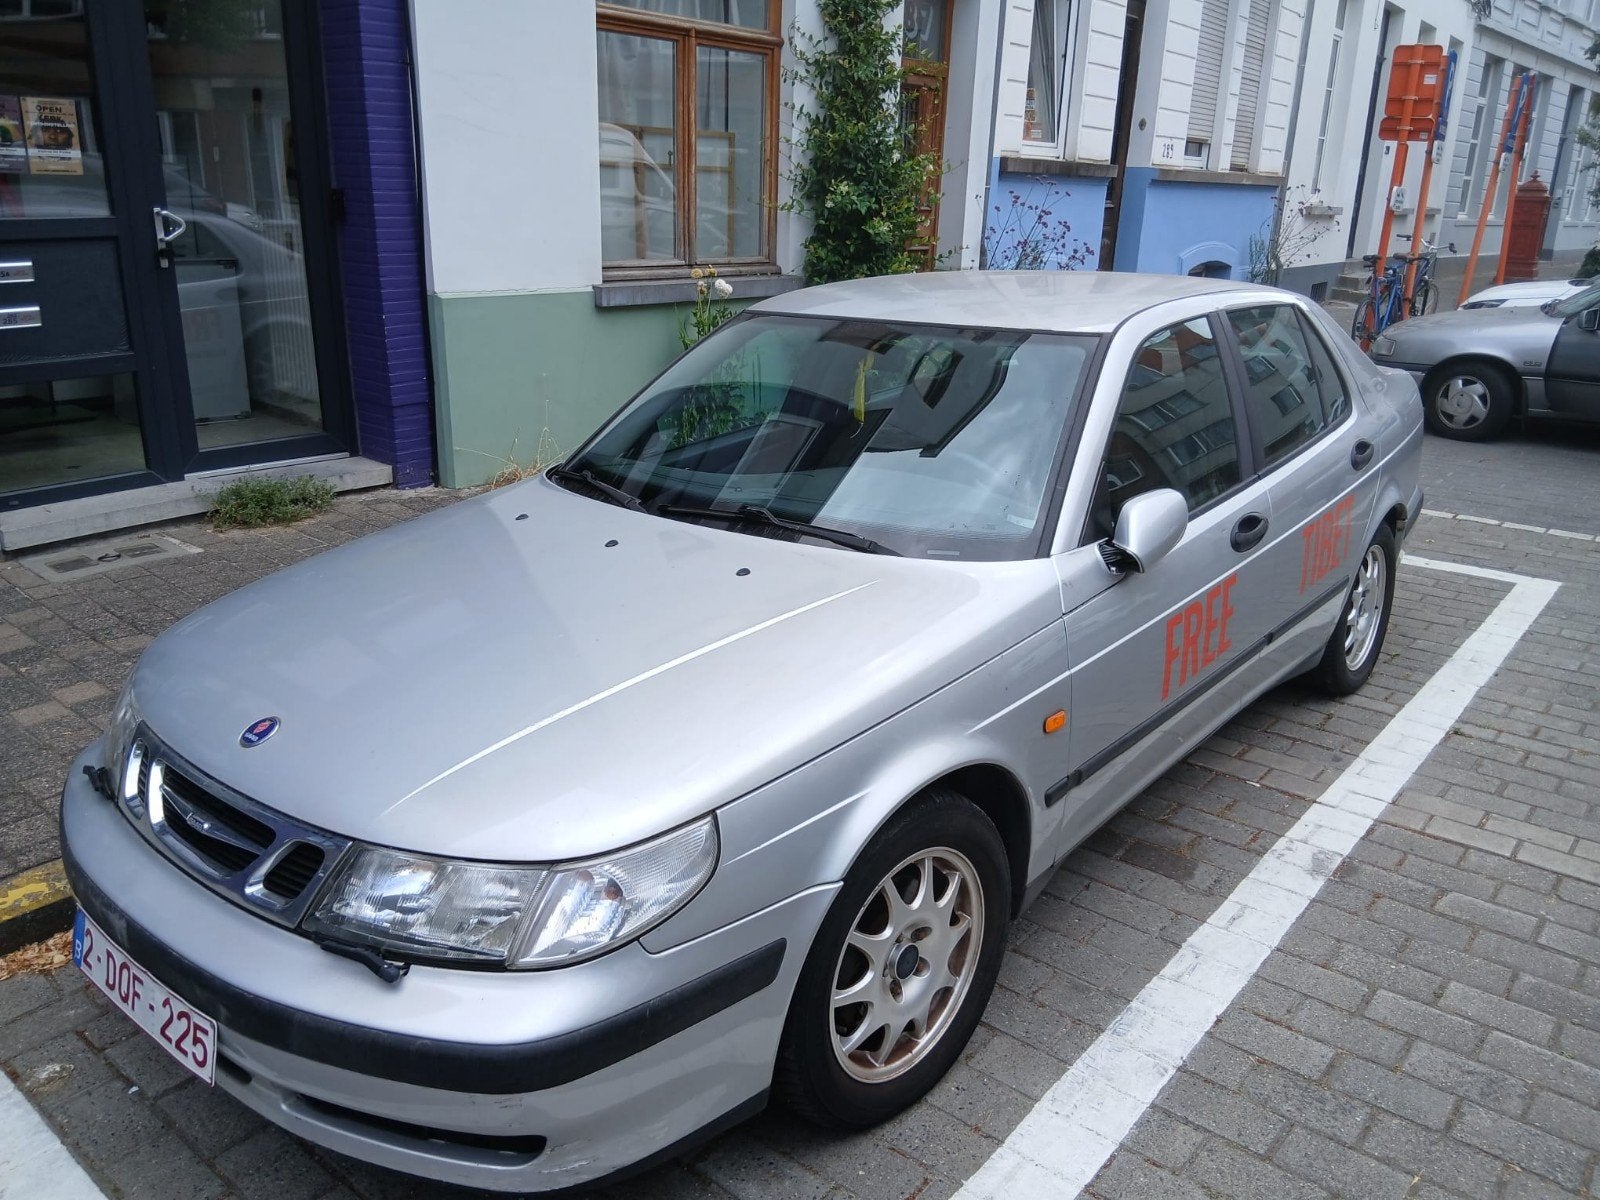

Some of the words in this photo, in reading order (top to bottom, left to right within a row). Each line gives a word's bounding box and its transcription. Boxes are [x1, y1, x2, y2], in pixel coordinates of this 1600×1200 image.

[35, 104, 62, 113] OPEN
[1161, 572, 1238, 701] FREE
[1299, 494, 1355, 596] TIBET
[75, 939, 83, 960] B
[82, 927, 209, 1069] 2-DQF-225
